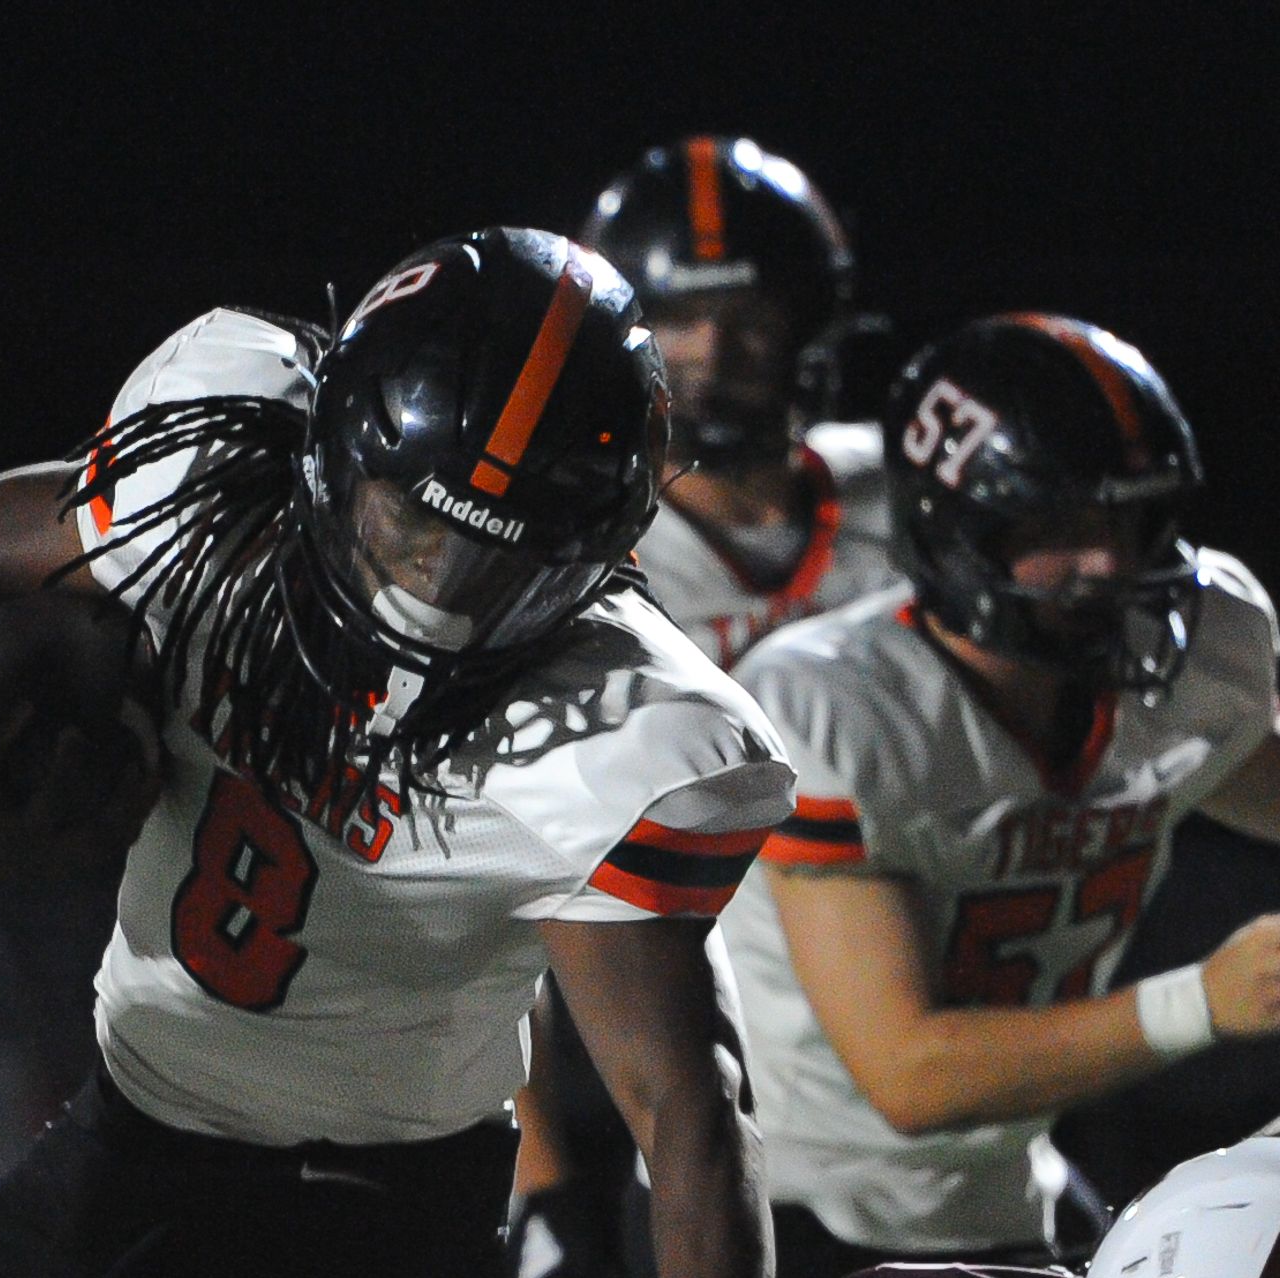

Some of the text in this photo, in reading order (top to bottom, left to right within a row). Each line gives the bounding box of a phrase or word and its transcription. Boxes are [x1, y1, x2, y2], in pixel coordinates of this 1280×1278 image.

[902, 377, 1001, 490] 57
[422, 479, 525, 543] Riddell
[170, 766, 320, 1013] 8
[933, 842, 1157, 1006] 57
